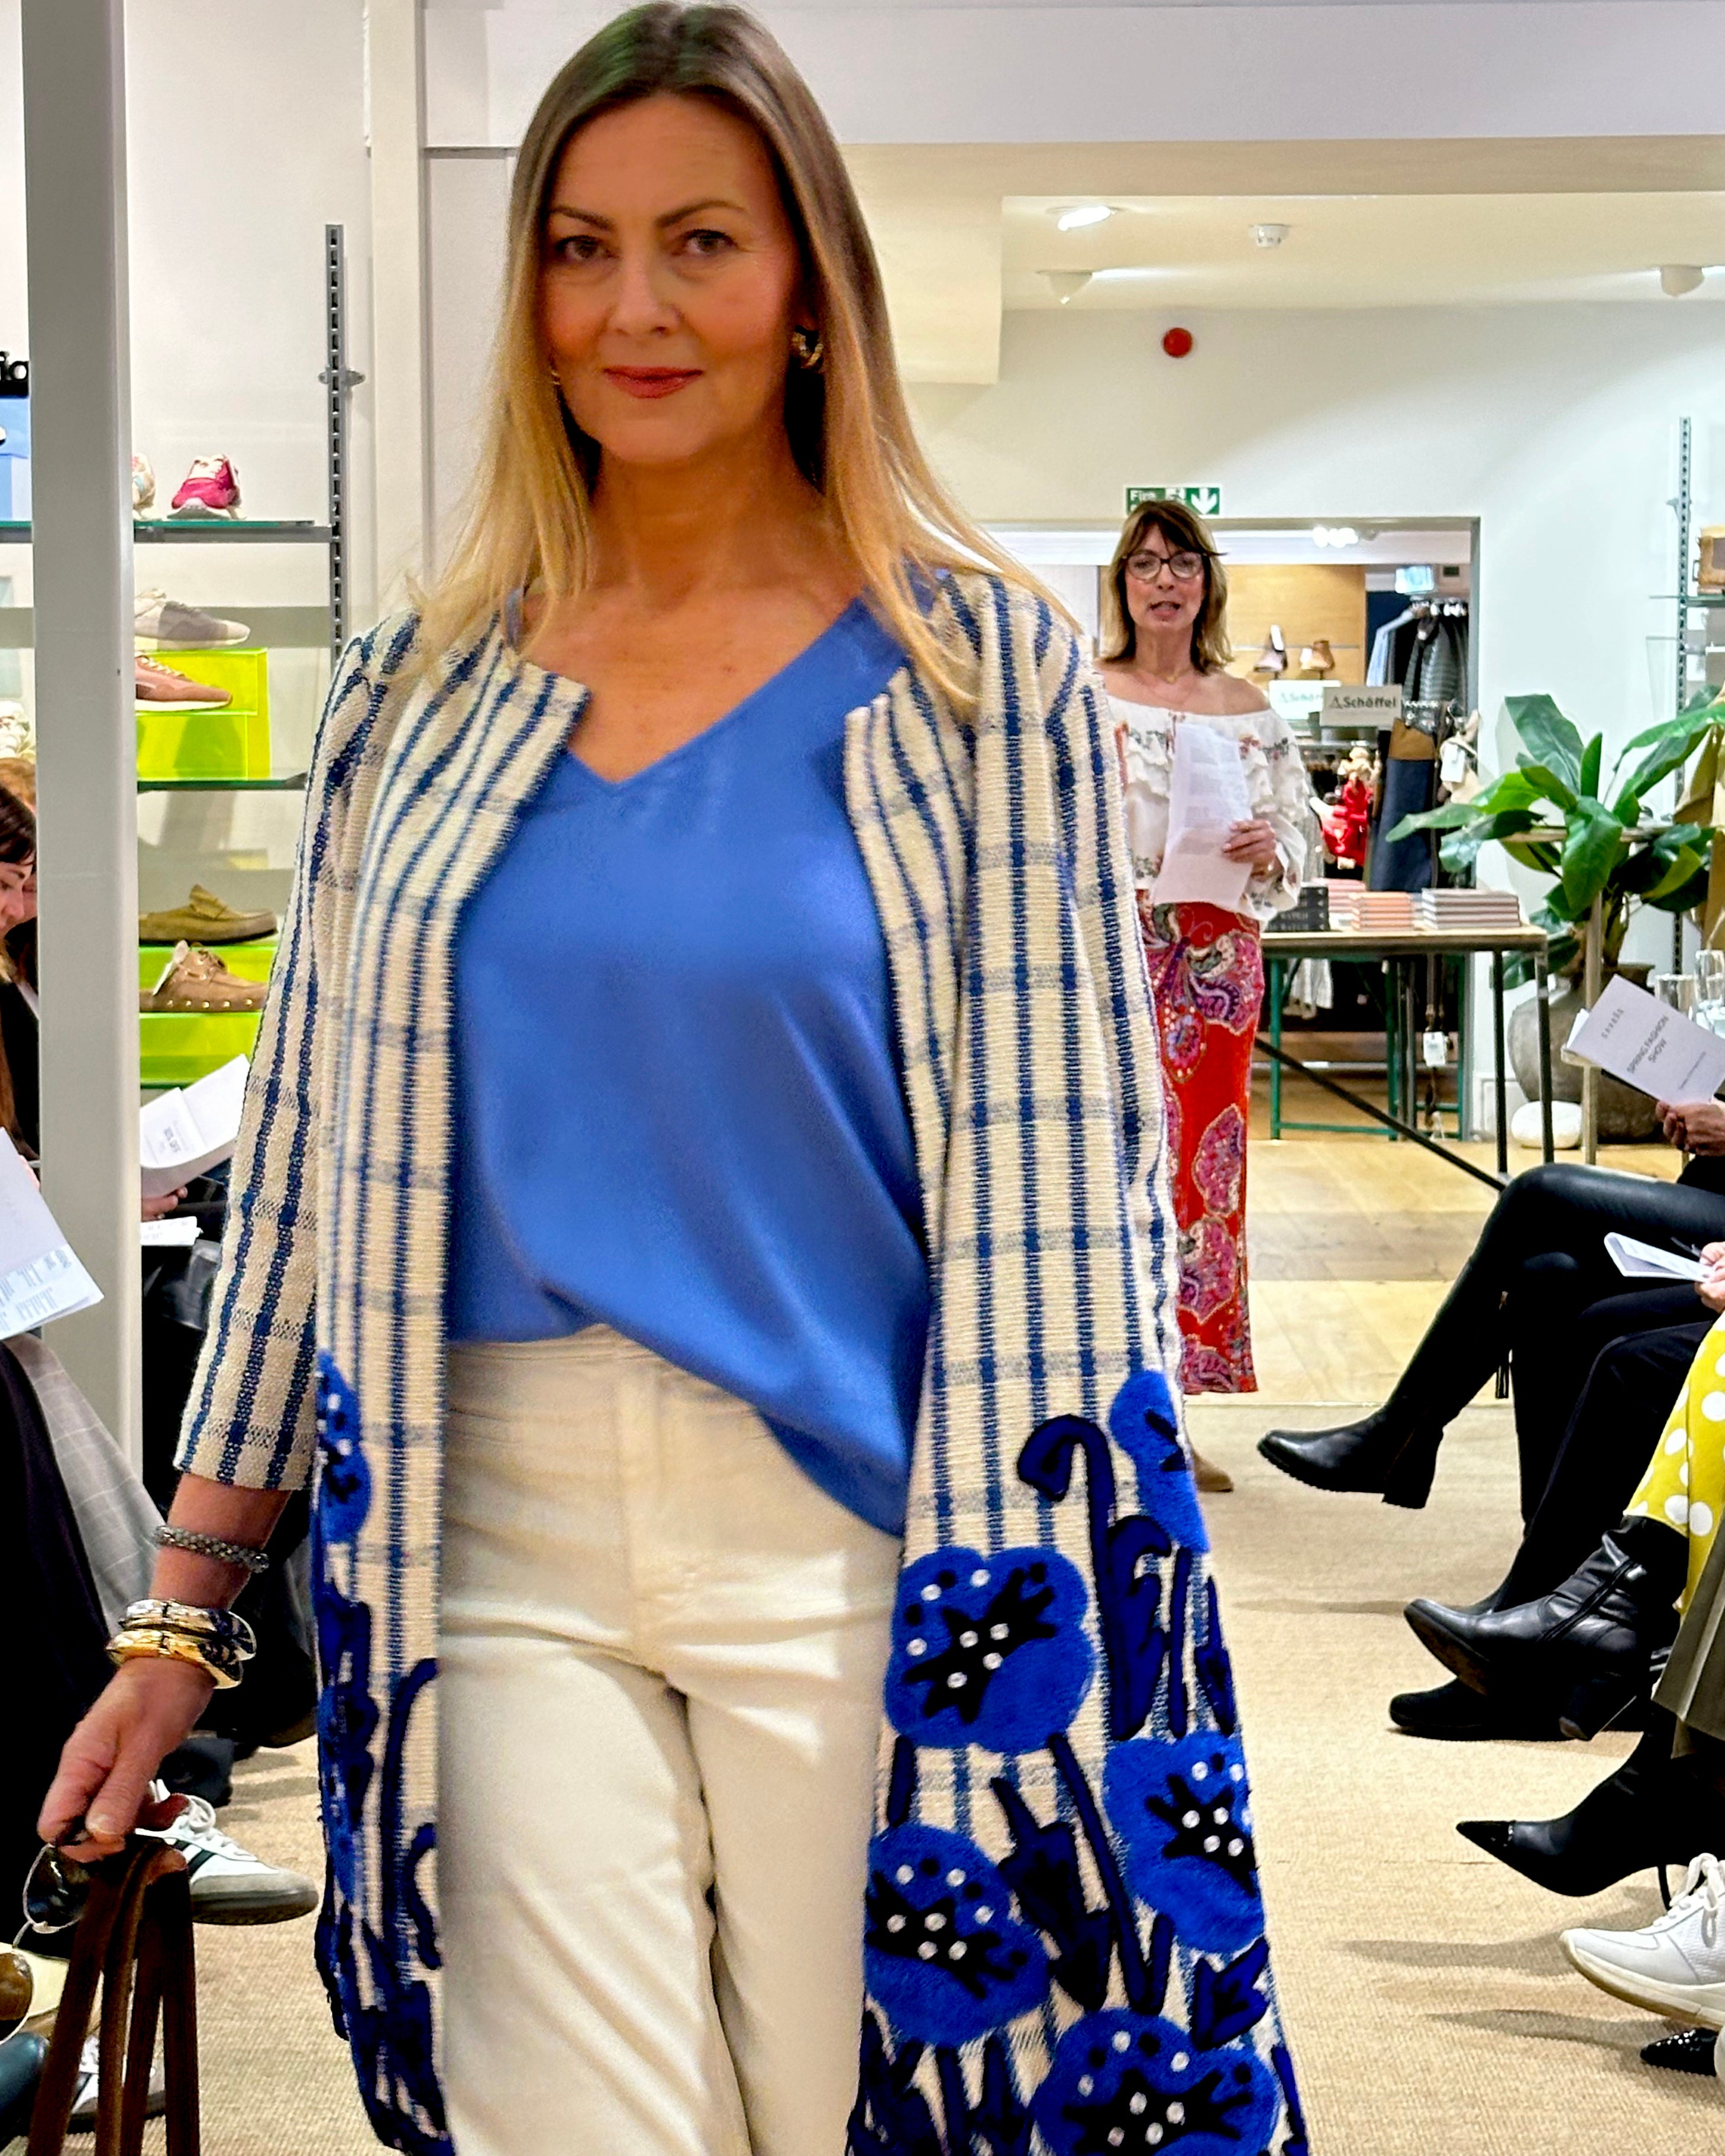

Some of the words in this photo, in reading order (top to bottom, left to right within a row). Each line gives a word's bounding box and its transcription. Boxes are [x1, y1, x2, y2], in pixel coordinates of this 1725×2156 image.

[1343, 696, 1396, 708] Schöffel
[1644, 1015, 1669, 1049] FASHION
[1648, 1037, 1667, 1063] SHOW
